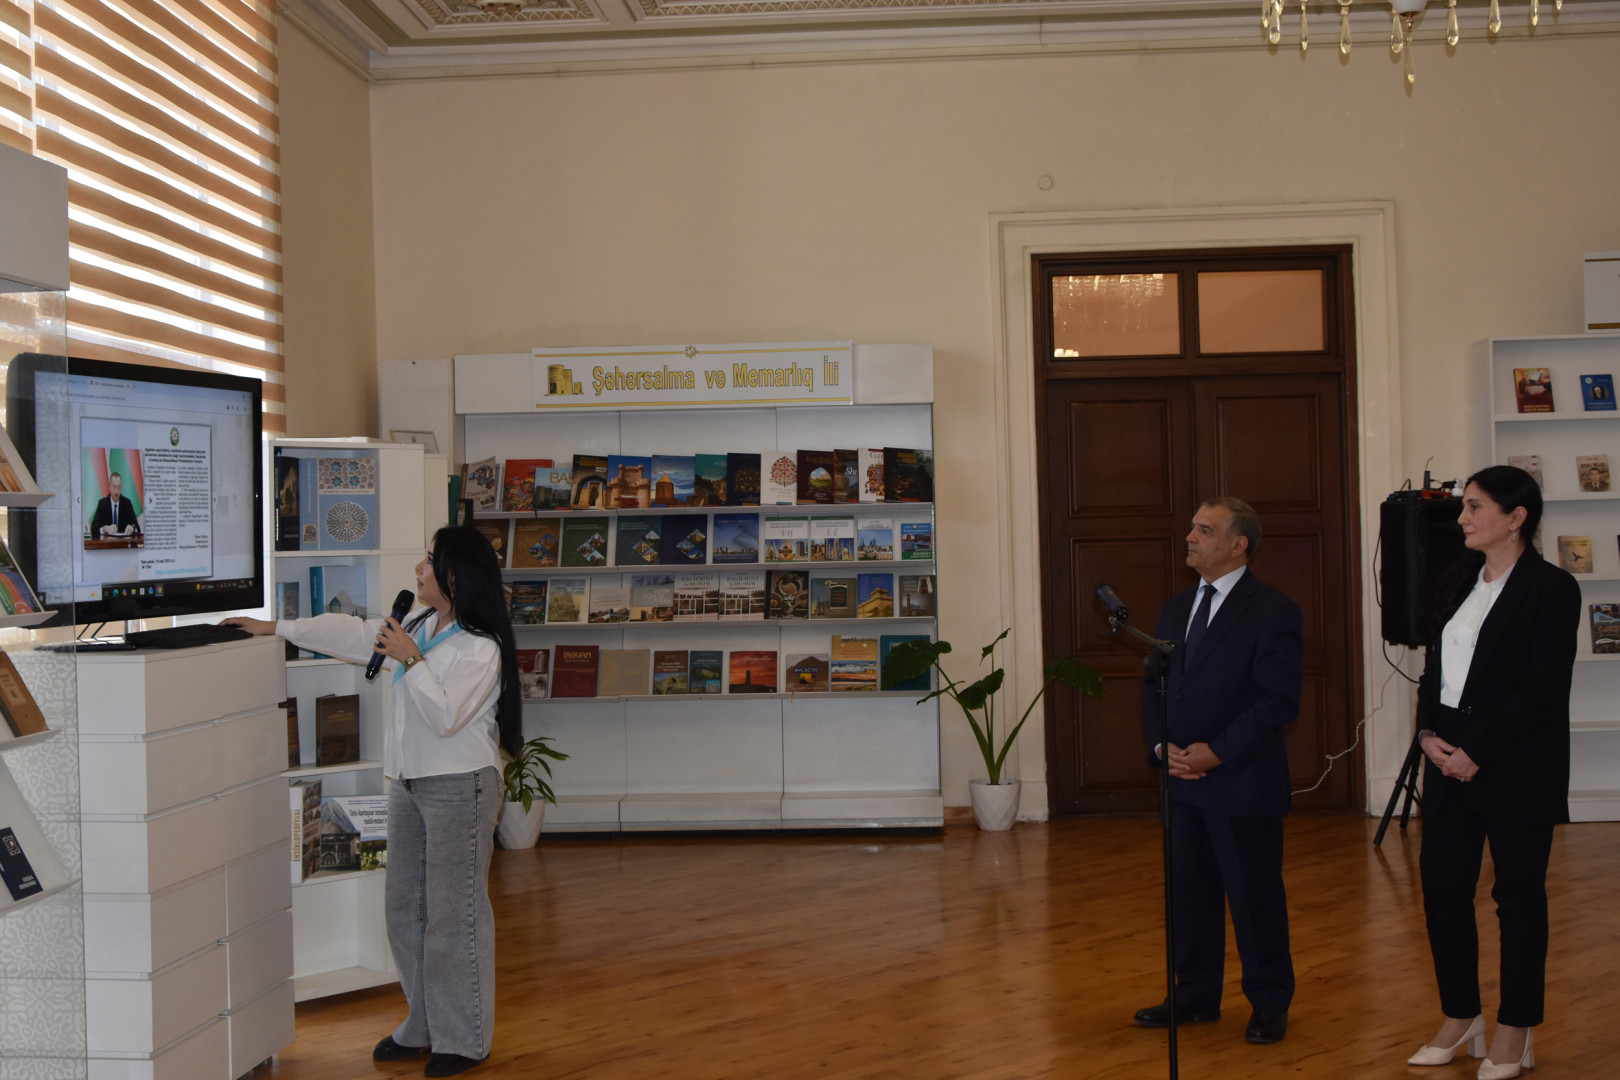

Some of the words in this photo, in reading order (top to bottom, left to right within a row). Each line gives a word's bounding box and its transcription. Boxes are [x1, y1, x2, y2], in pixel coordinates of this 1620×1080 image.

[592, 365, 696, 396] Şəhərsalma
[704, 368, 726, 389] və
[732, 362, 814, 392] Memarlıq
[823, 356, 839, 386] İli
